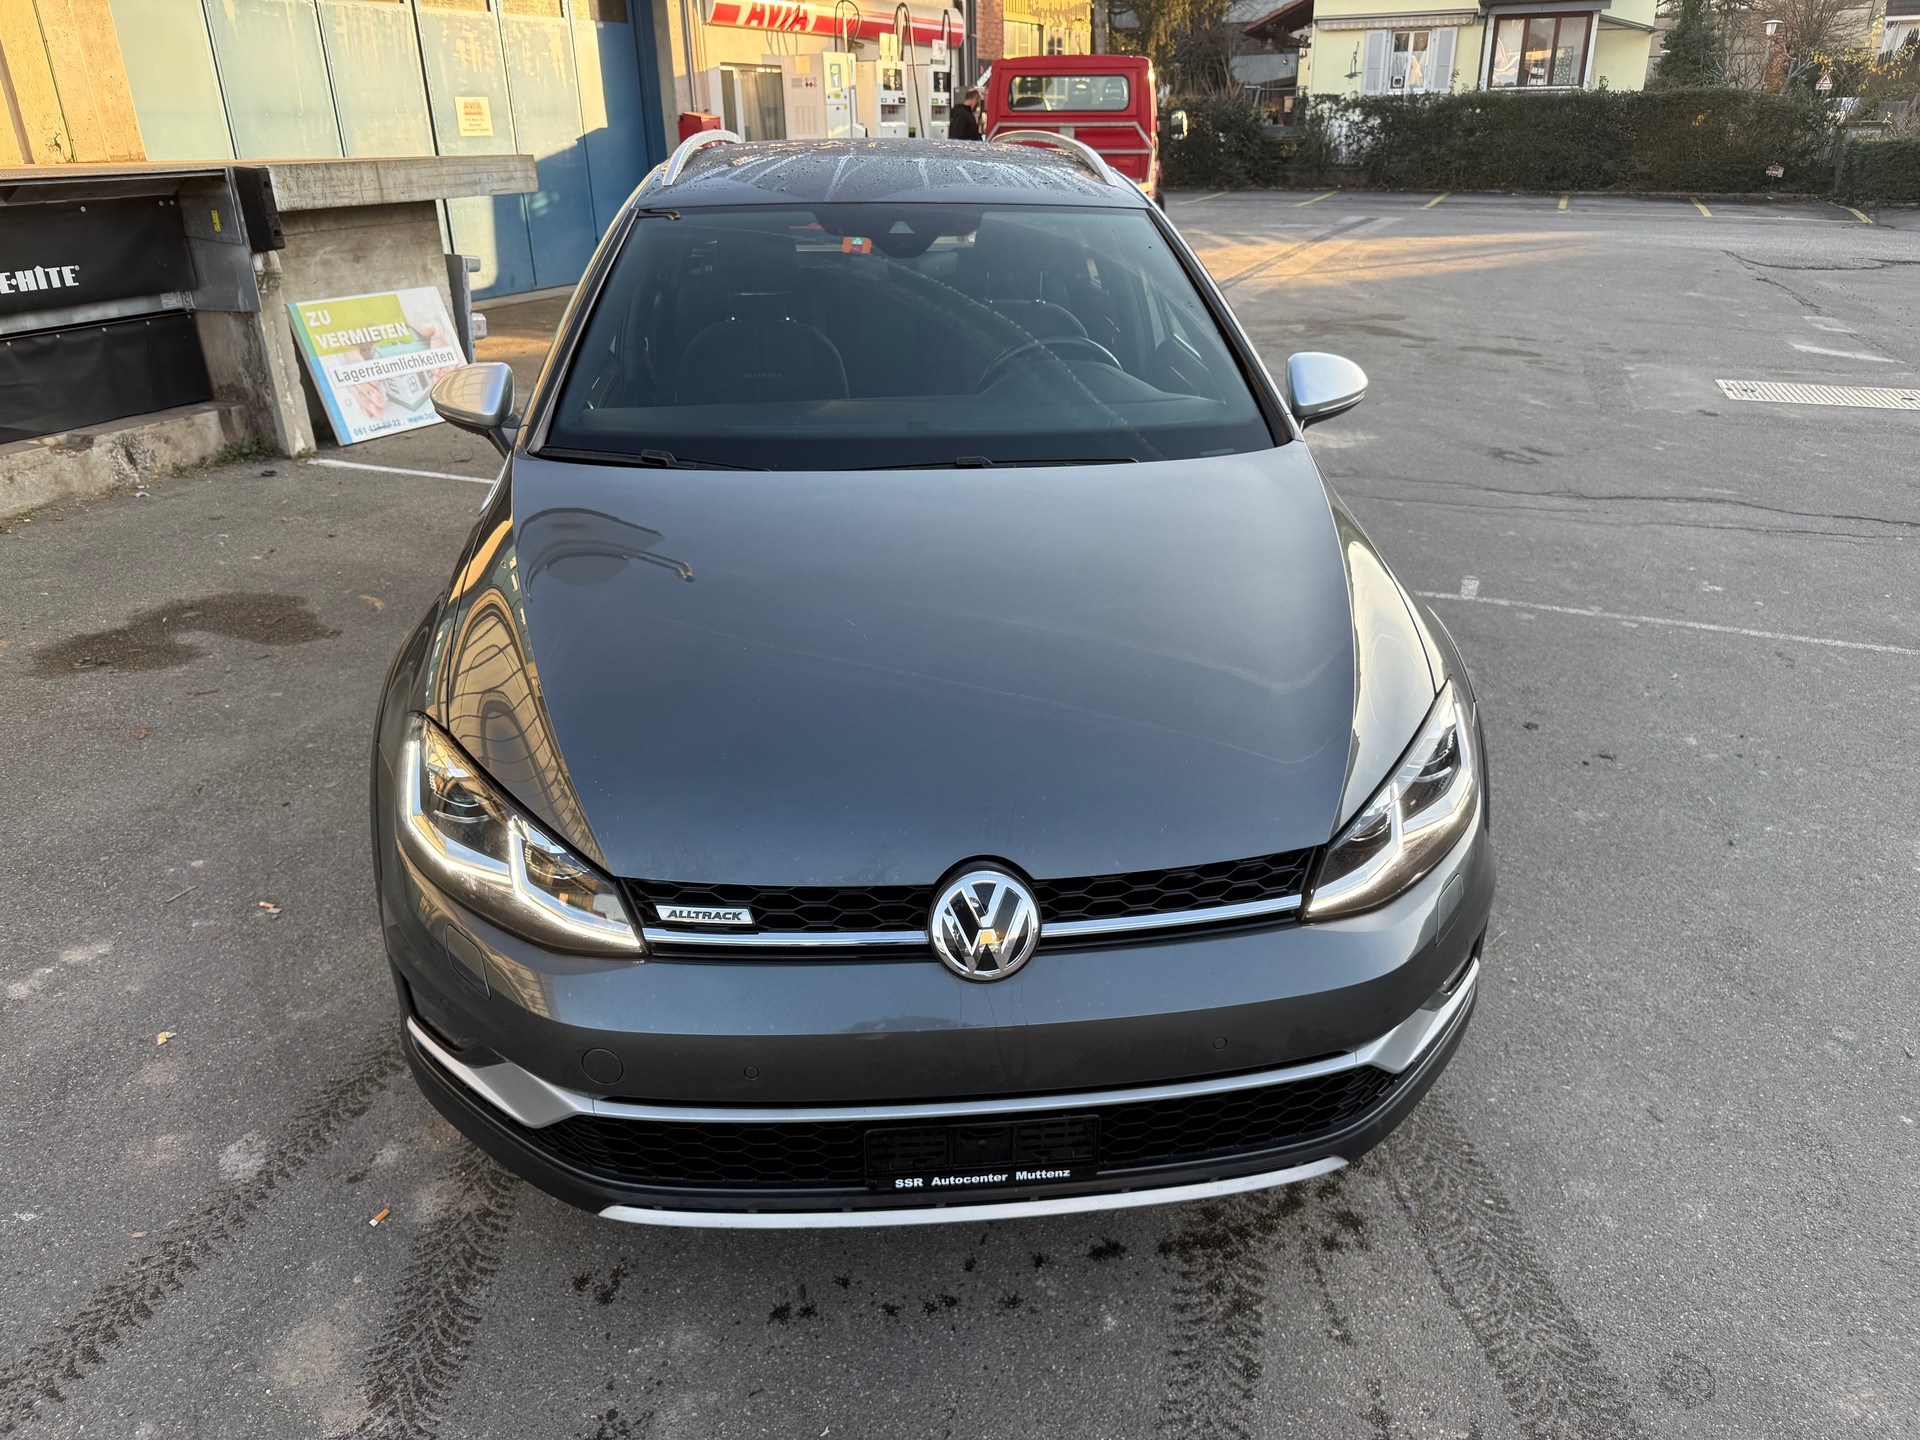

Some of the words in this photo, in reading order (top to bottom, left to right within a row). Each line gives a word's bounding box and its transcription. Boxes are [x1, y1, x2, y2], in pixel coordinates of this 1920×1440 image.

[744, 2, 809, 31] AVIA
[464, 100, 482, 109] AVIA
[305, 309, 332, 327] ZU
[315, 322, 409, 349] VERMIETEN
[334, 351, 454, 383] Lagerräumlichkeiten
[667, 909, 742, 921] ALLTRACK
[895, 1178, 923, 1188] SSR
[931, 1173, 1008, 1186] Autocenter
[1015, 1169, 1071, 1181] Muttenz
